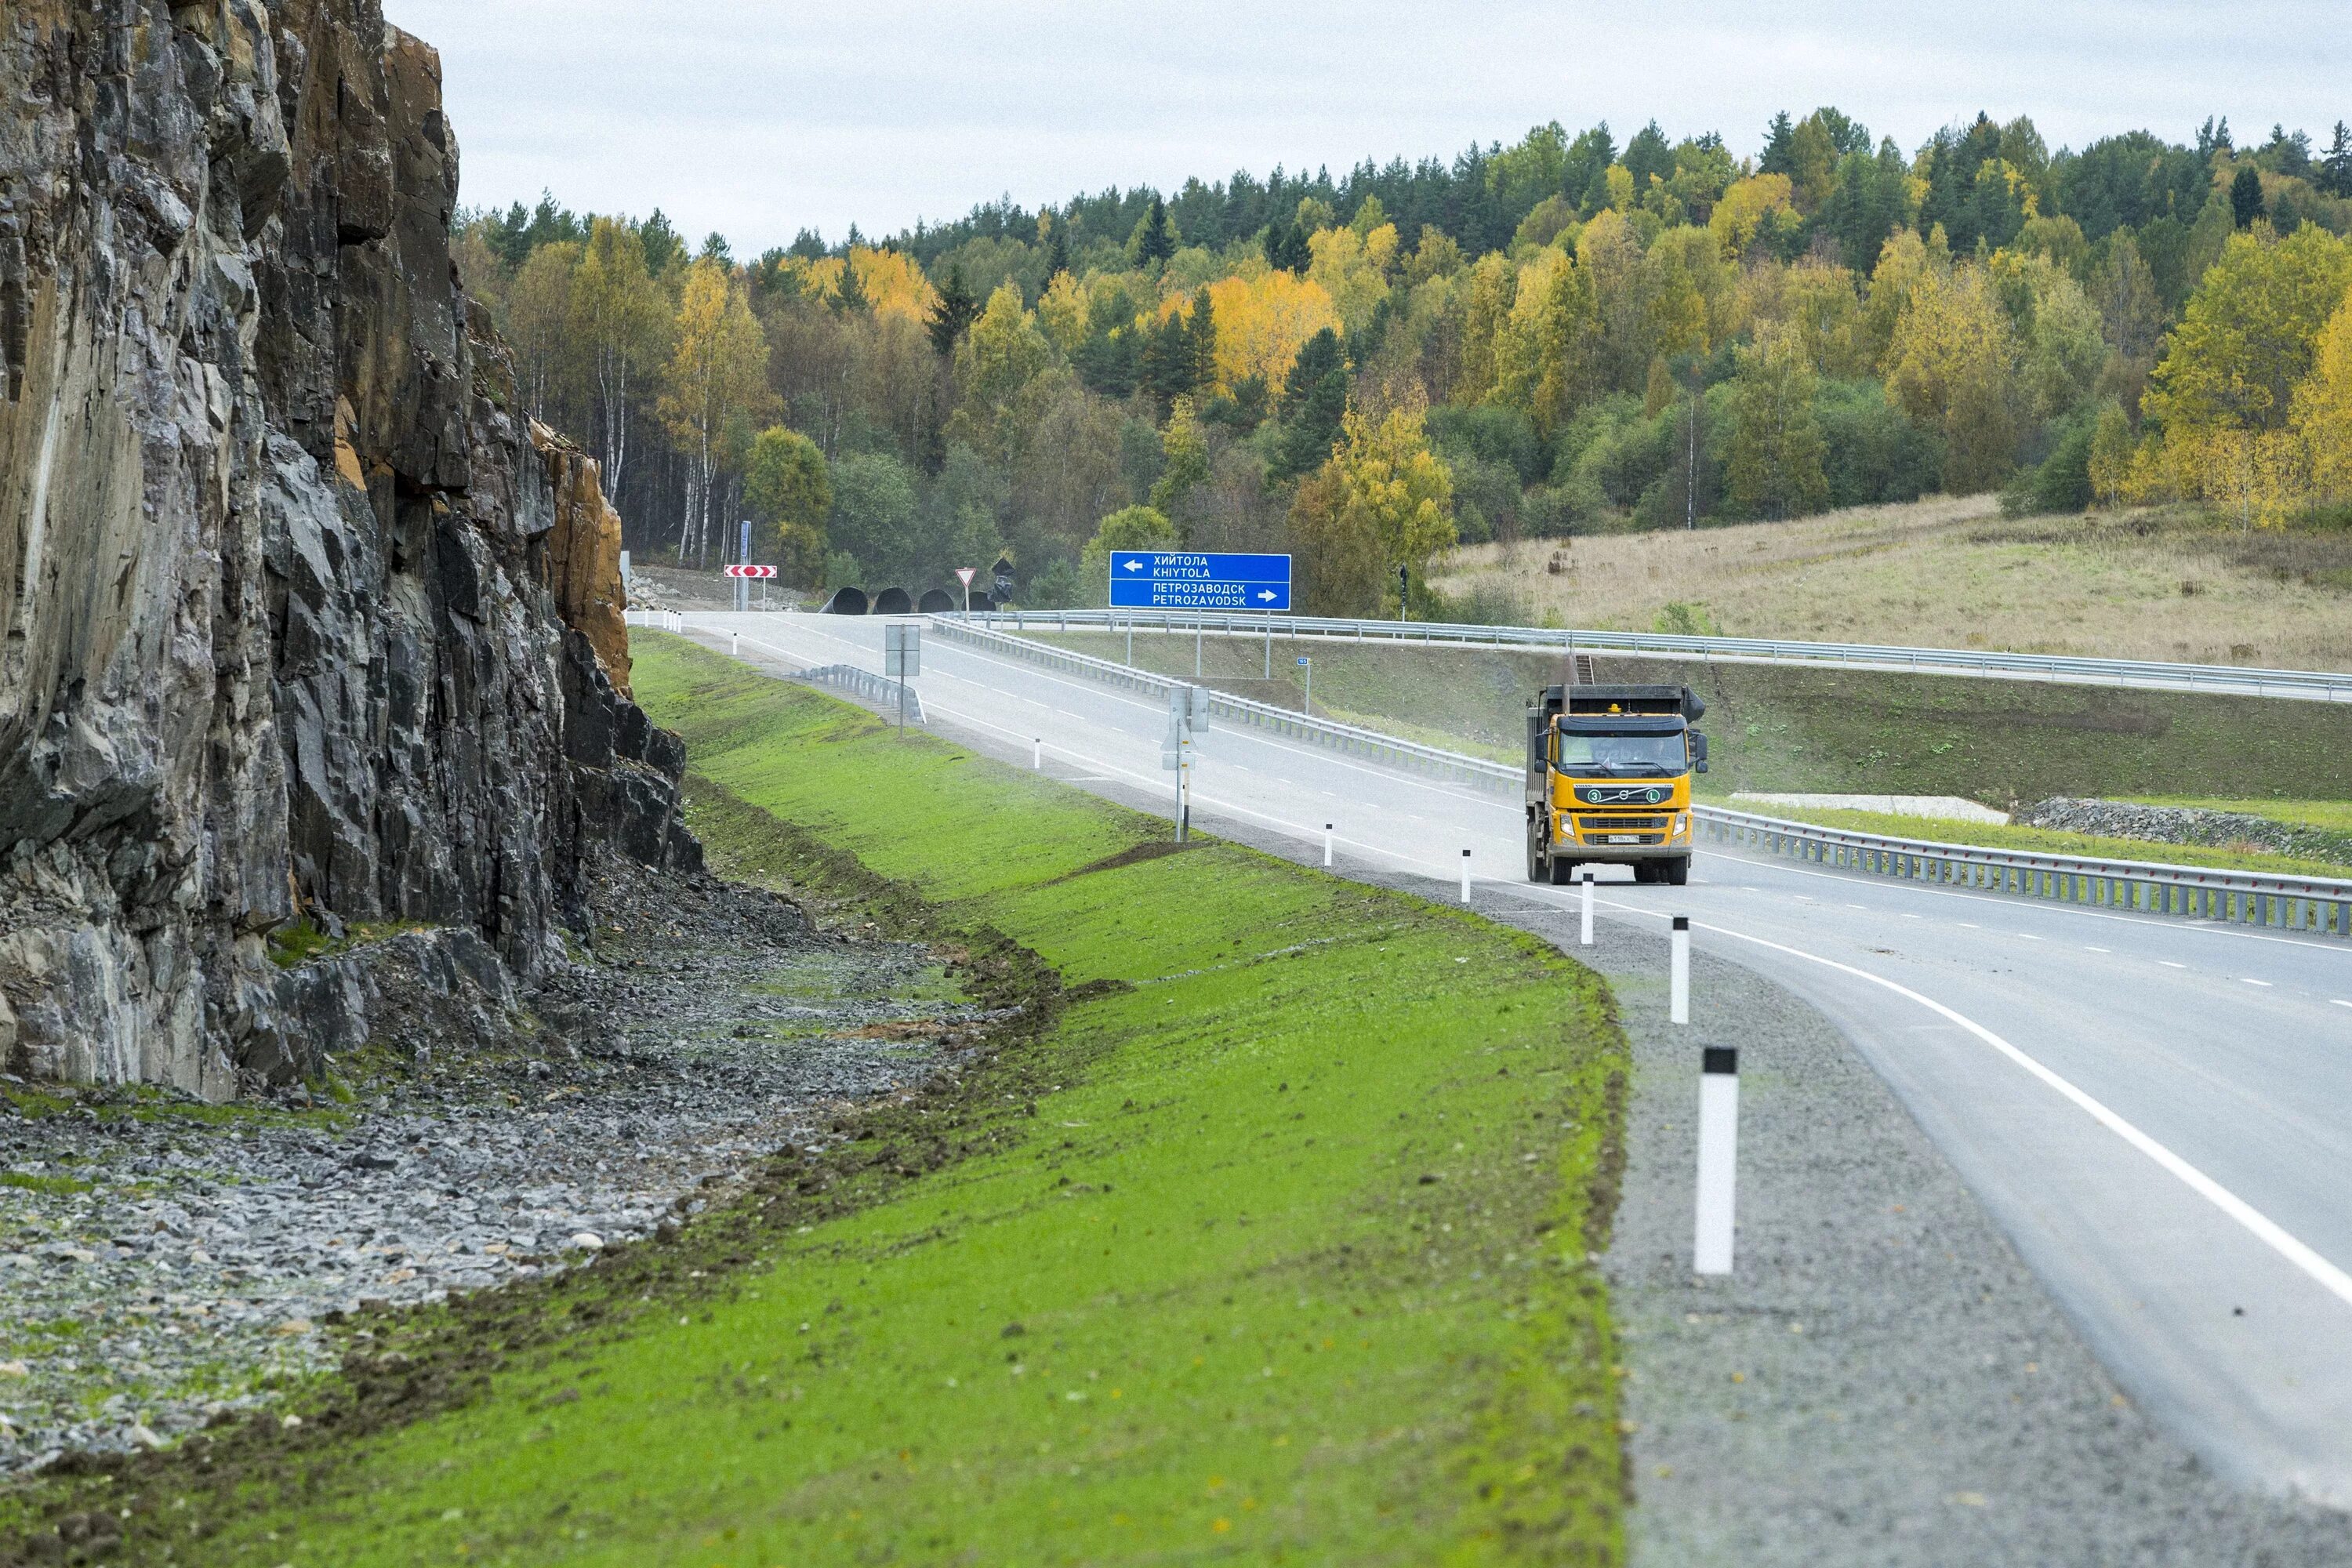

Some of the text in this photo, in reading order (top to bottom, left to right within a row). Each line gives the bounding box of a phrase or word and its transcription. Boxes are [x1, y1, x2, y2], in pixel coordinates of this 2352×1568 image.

[1153, 553, 1208, 566] ХИЙТОЛА
[1153, 568, 1210, 578] KHIYTOLA
[1153, 583, 1245, 595] ПЕТРОЗАВОДСК
[1152, 594, 1246, 606] PETROZAVODSK
[1592, 792, 1598, 801] 3
[1650, 792, 1656, 801] L
